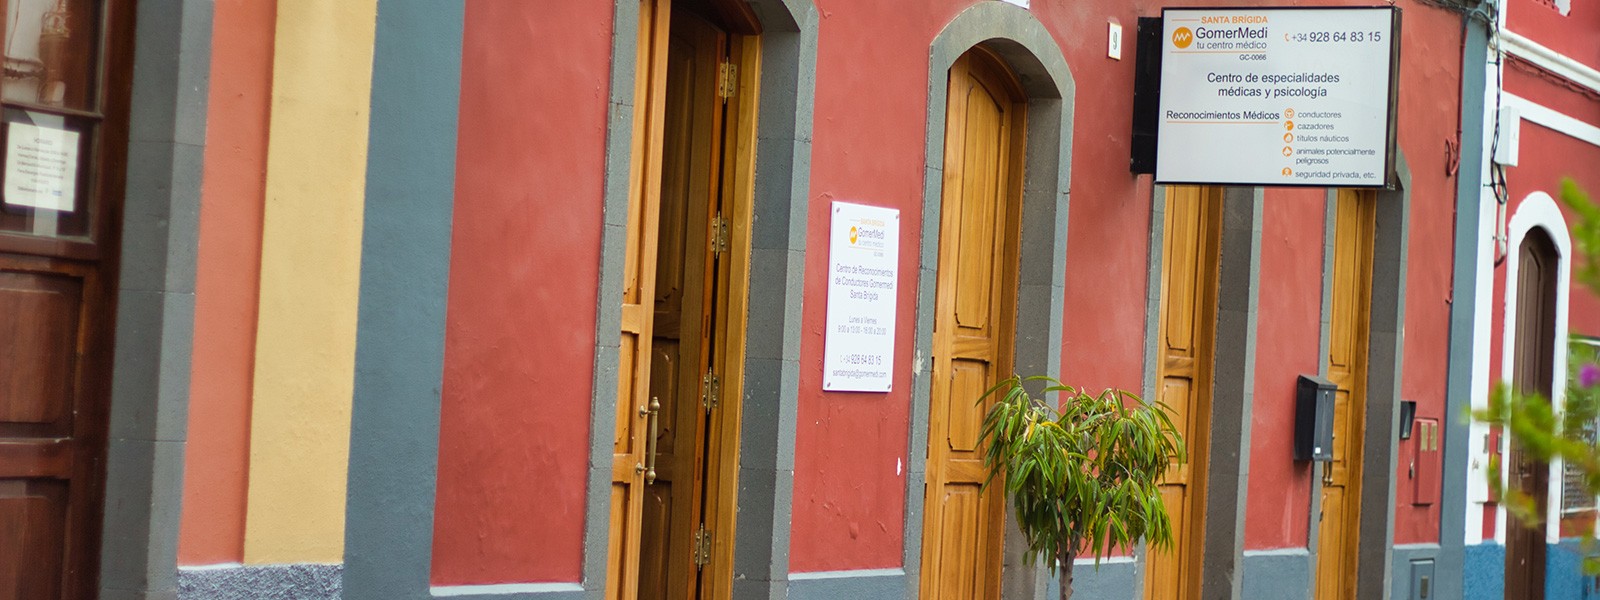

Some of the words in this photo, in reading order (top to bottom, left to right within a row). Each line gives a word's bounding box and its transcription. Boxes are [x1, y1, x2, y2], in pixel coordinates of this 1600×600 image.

[1201, 16, 1230, 24] SANTA
[1232, 14, 1268, 24] BRÍGIDA
[1196, 27, 1268, 40] GomerMedi
[1309, 32, 1330, 42] 928
[1333, 32, 1346, 42] 64
[1350, 32, 1364, 42] 83
[1369, 32, 1381, 42] 15
[1196, 41, 1205, 49] tu
[1235, 40, 1267, 49] médico
[1207, 72, 1243, 83] Centro
[1245, 72, 1259, 83] de
[1261, 73, 1340, 85] especialidades
[1218, 86, 1262, 97] médicas
[1264, 89, 1271, 99] y
[1274, 86, 1327, 99] psicología
[1166, 111, 1241, 120] Reconocimientos
[1243, 110, 1280, 120] Médicos
[1298, 110, 1342, 119] conductores
[1297, 134, 1318, 142] títulos
[1320, 134, 1349, 143] náuticos
[1326, 148, 1376, 157] potencialmente
[1296, 157, 1329, 165] peligrosos
[1295, 170, 1331, 179] seguridad
[1332, 170, 1361, 180] privada,
[836, 263, 851, 273] Centro
[858, 266, 893, 277] Reconocimientos
[835, 277, 841, 285] de
[842, 276, 869, 287] Conductores
[850, 290, 863, 299] Santa
[851, 354, 860, 364] 928
[861, 354, 867, 365] 64
[876, 355, 881, 365] 15
